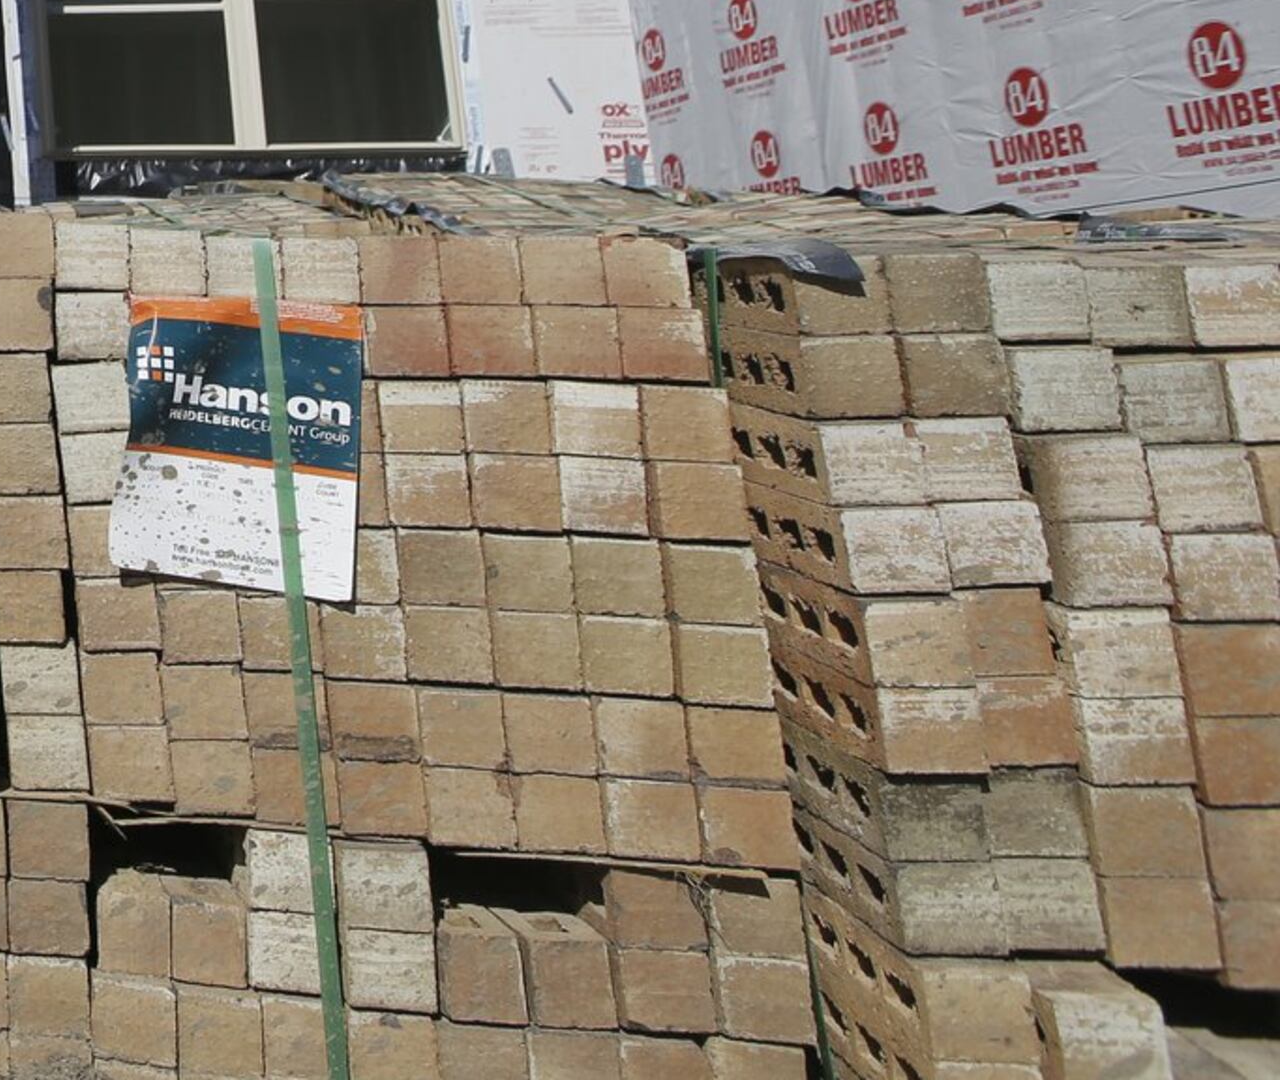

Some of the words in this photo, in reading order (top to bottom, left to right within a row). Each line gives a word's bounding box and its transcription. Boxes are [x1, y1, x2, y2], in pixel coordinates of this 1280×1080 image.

[730, 0, 755, 32] 84
[644, 34, 664, 65] 84
[720, 35, 778, 74] LUMBER
[1192, 30, 1241, 78] 84
[642, 68, 685, 100] UMBER
[1008, 76, 1044, 117] 84
[866, 110, 896, 145] 84
[989, 123, 1088, 168] LUMBER
[604, 140, 649, 162] ply
[752, 138, 778, 170] 84
[850, 153, 928, 190] LUMBER
[169, 408, 306, 437] HEIDELBERGCENT
[309, 426, 351, 445] Group
